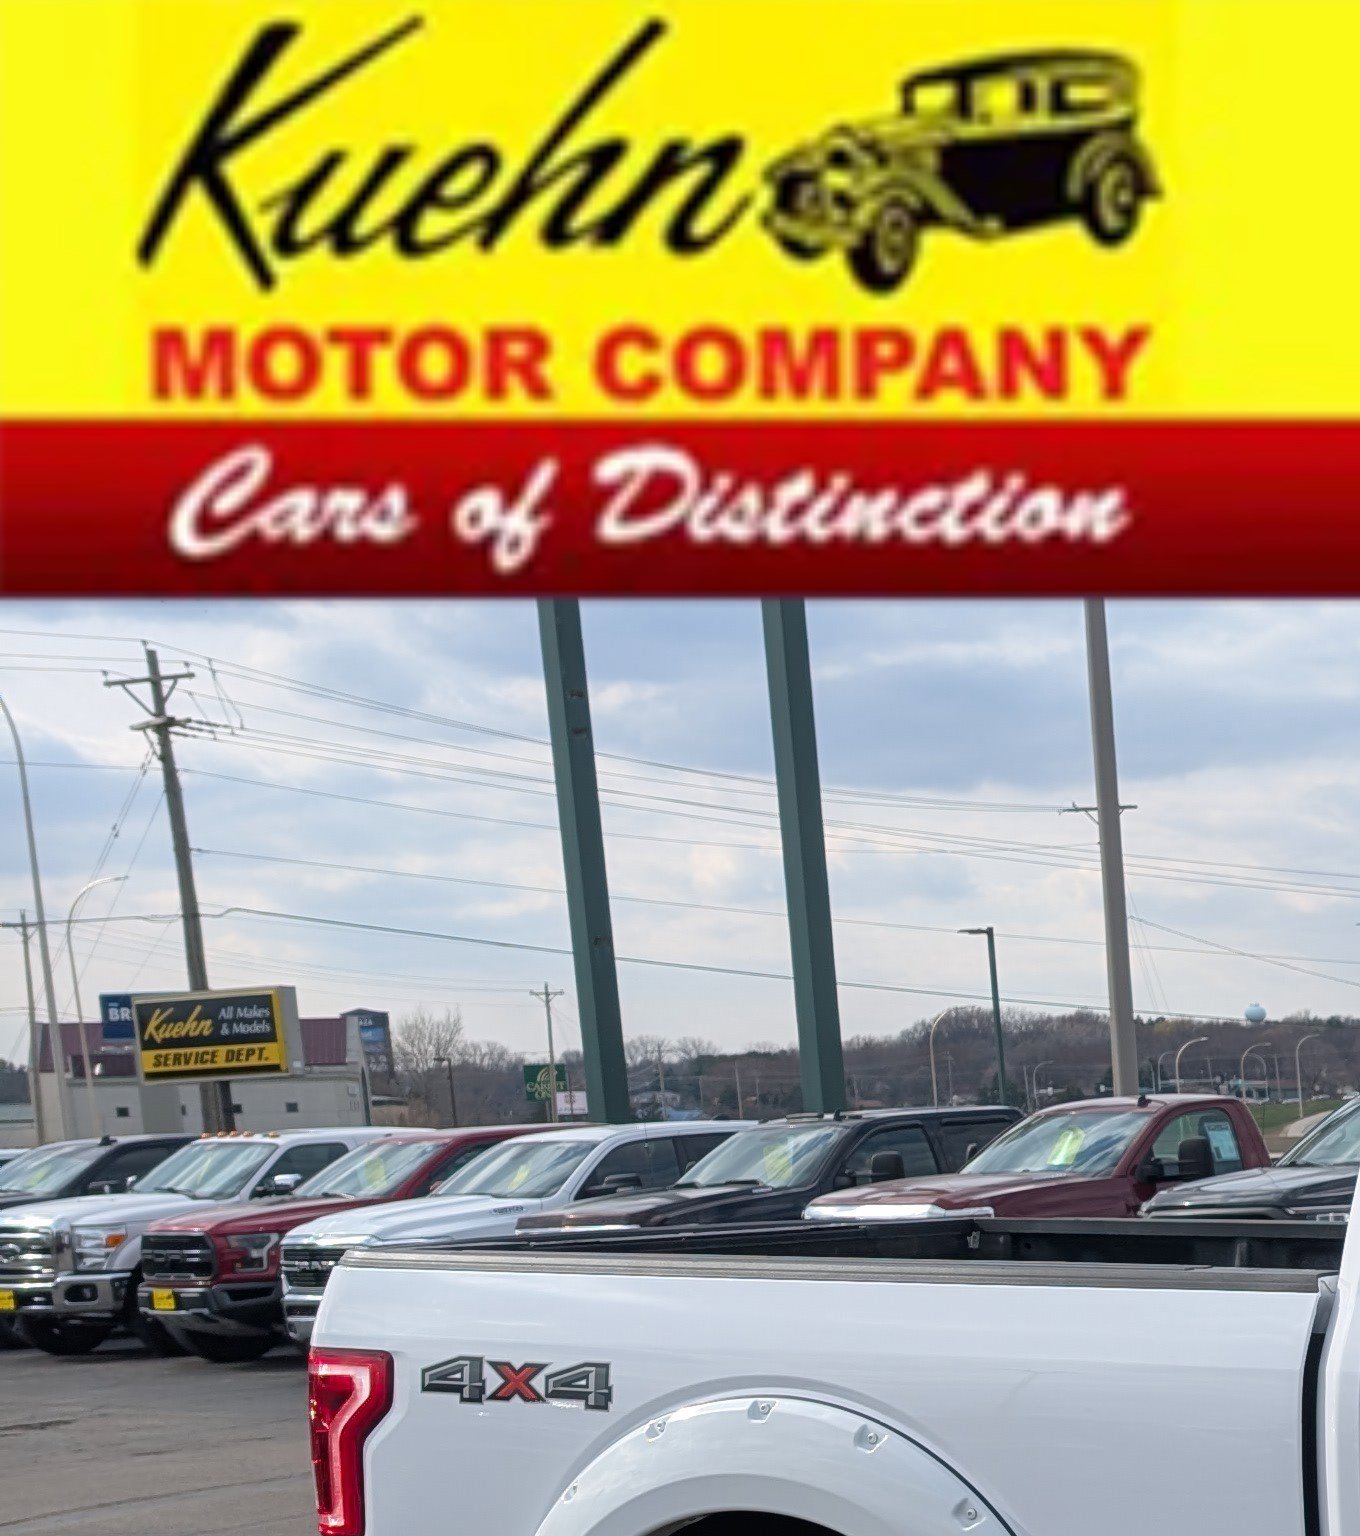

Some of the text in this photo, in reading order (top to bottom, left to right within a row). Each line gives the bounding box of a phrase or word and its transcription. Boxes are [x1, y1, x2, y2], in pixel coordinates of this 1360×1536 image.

[218, 1004, 271, 1021] All Makes
[144, 1005, 214, 1044] Kuehn
[220, 1020, 271, 1036] & Models
[152, 1047, 270, 1068] SERVICE DEPT.
[526, 1081, 565, 1093] CART
